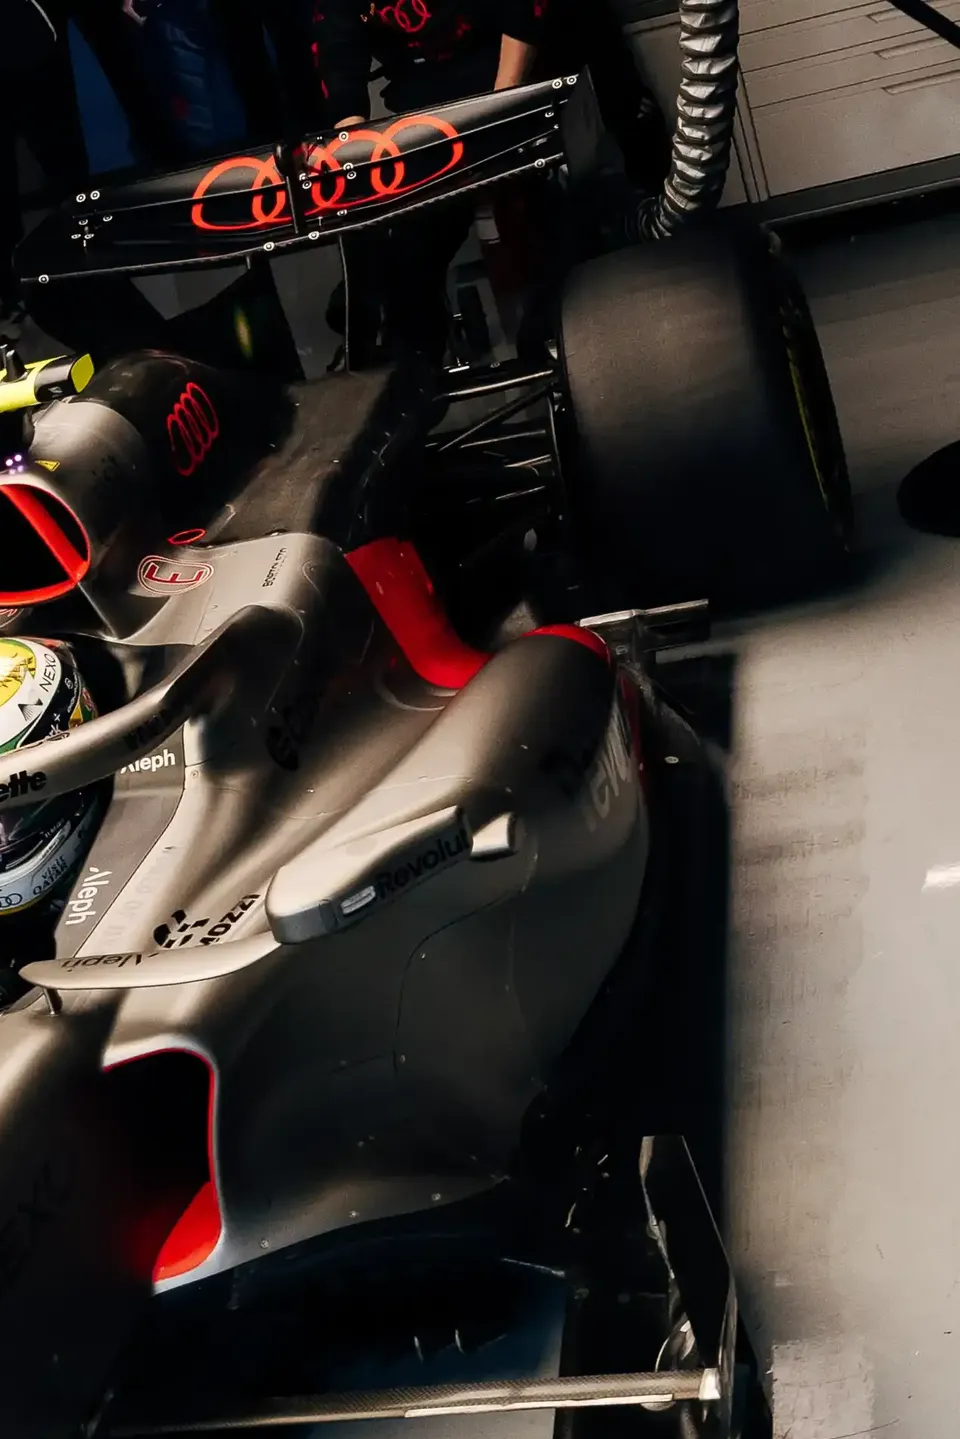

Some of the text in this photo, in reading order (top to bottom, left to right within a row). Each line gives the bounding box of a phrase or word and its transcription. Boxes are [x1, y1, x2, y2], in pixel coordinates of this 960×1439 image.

[39, 653, 57, 693] NEXO
[375, 828, 470, 899] Revolut
[64, 866, 113, 926] Aleph
